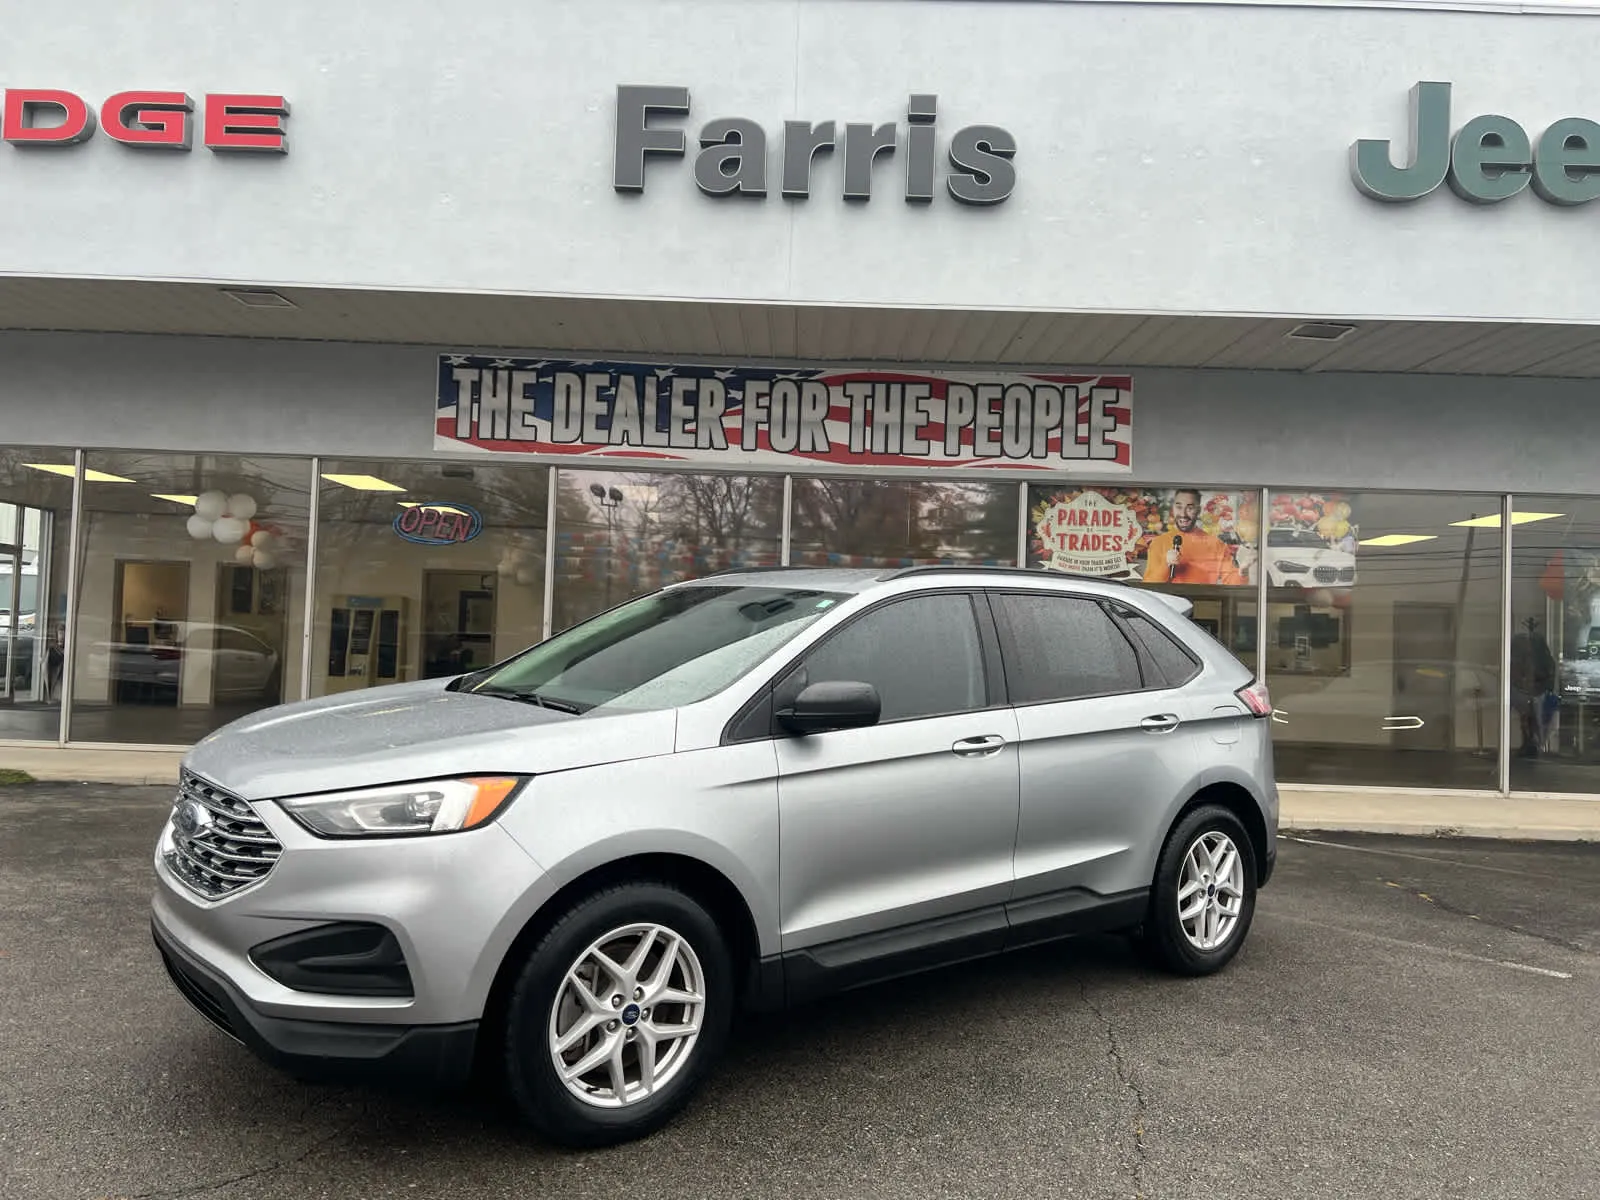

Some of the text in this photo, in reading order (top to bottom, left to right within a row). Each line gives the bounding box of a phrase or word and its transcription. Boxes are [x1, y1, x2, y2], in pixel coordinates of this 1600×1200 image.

[3, 88, 290, 155] DGE
[613, 84, 1018, 205] Farris
[1349, 81, 1600, 206] Jee
[451, 367, 1122, 460] THE DEALER FOR THE PEOPLE
[400, 506, 473, 542] OPEN
[1056, 533, 1122, 552] TRADES
[1057, 509, 1122, 527] PARADE
